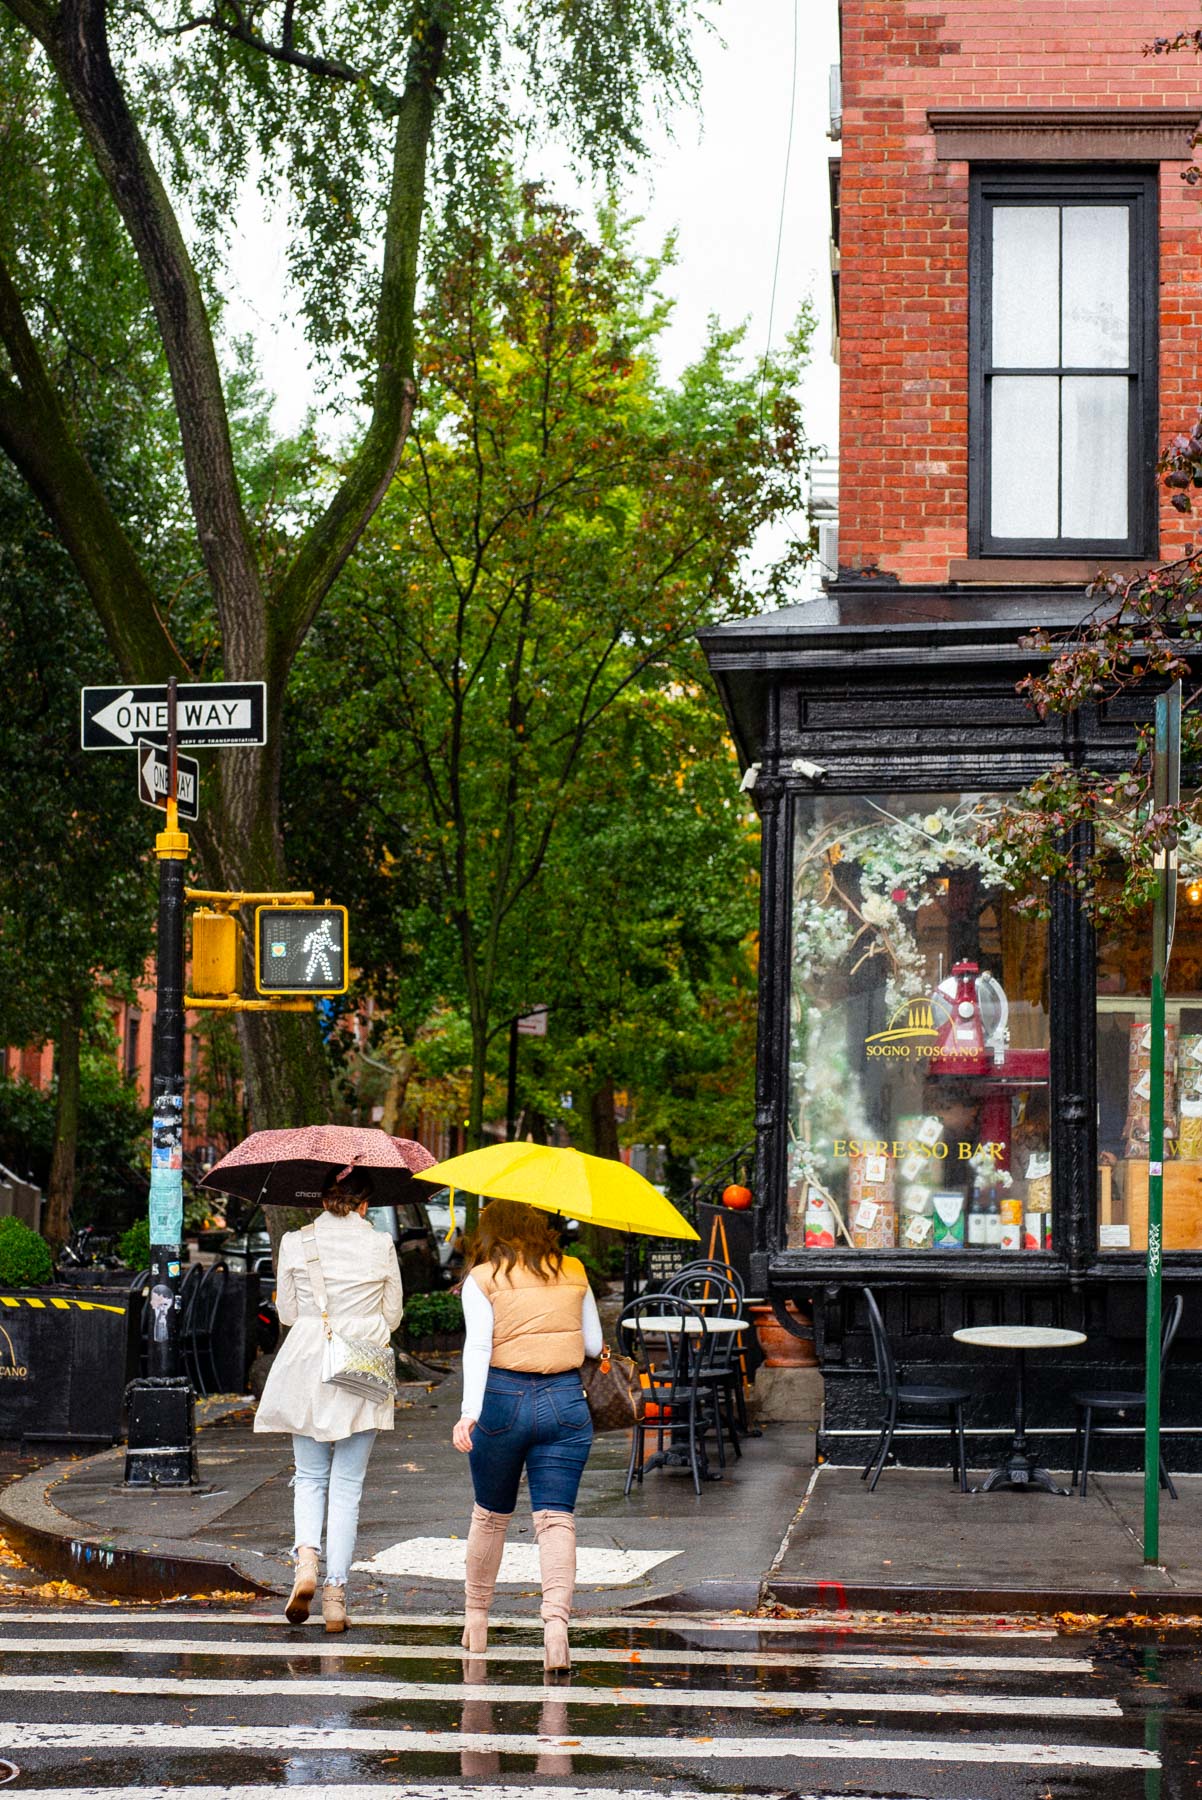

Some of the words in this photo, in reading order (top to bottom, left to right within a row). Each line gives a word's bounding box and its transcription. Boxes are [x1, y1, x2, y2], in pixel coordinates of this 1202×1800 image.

[116, 705, 168, 729] ONE
[184, 703, 239, 727] WAY
[177, 770, 192, 798] AY
[866, 1045, 910, 1057] SOGNO
[833, 1139, 949, 1159] ESPRESSO
[957, 1142, 1004, 1160] BAR
